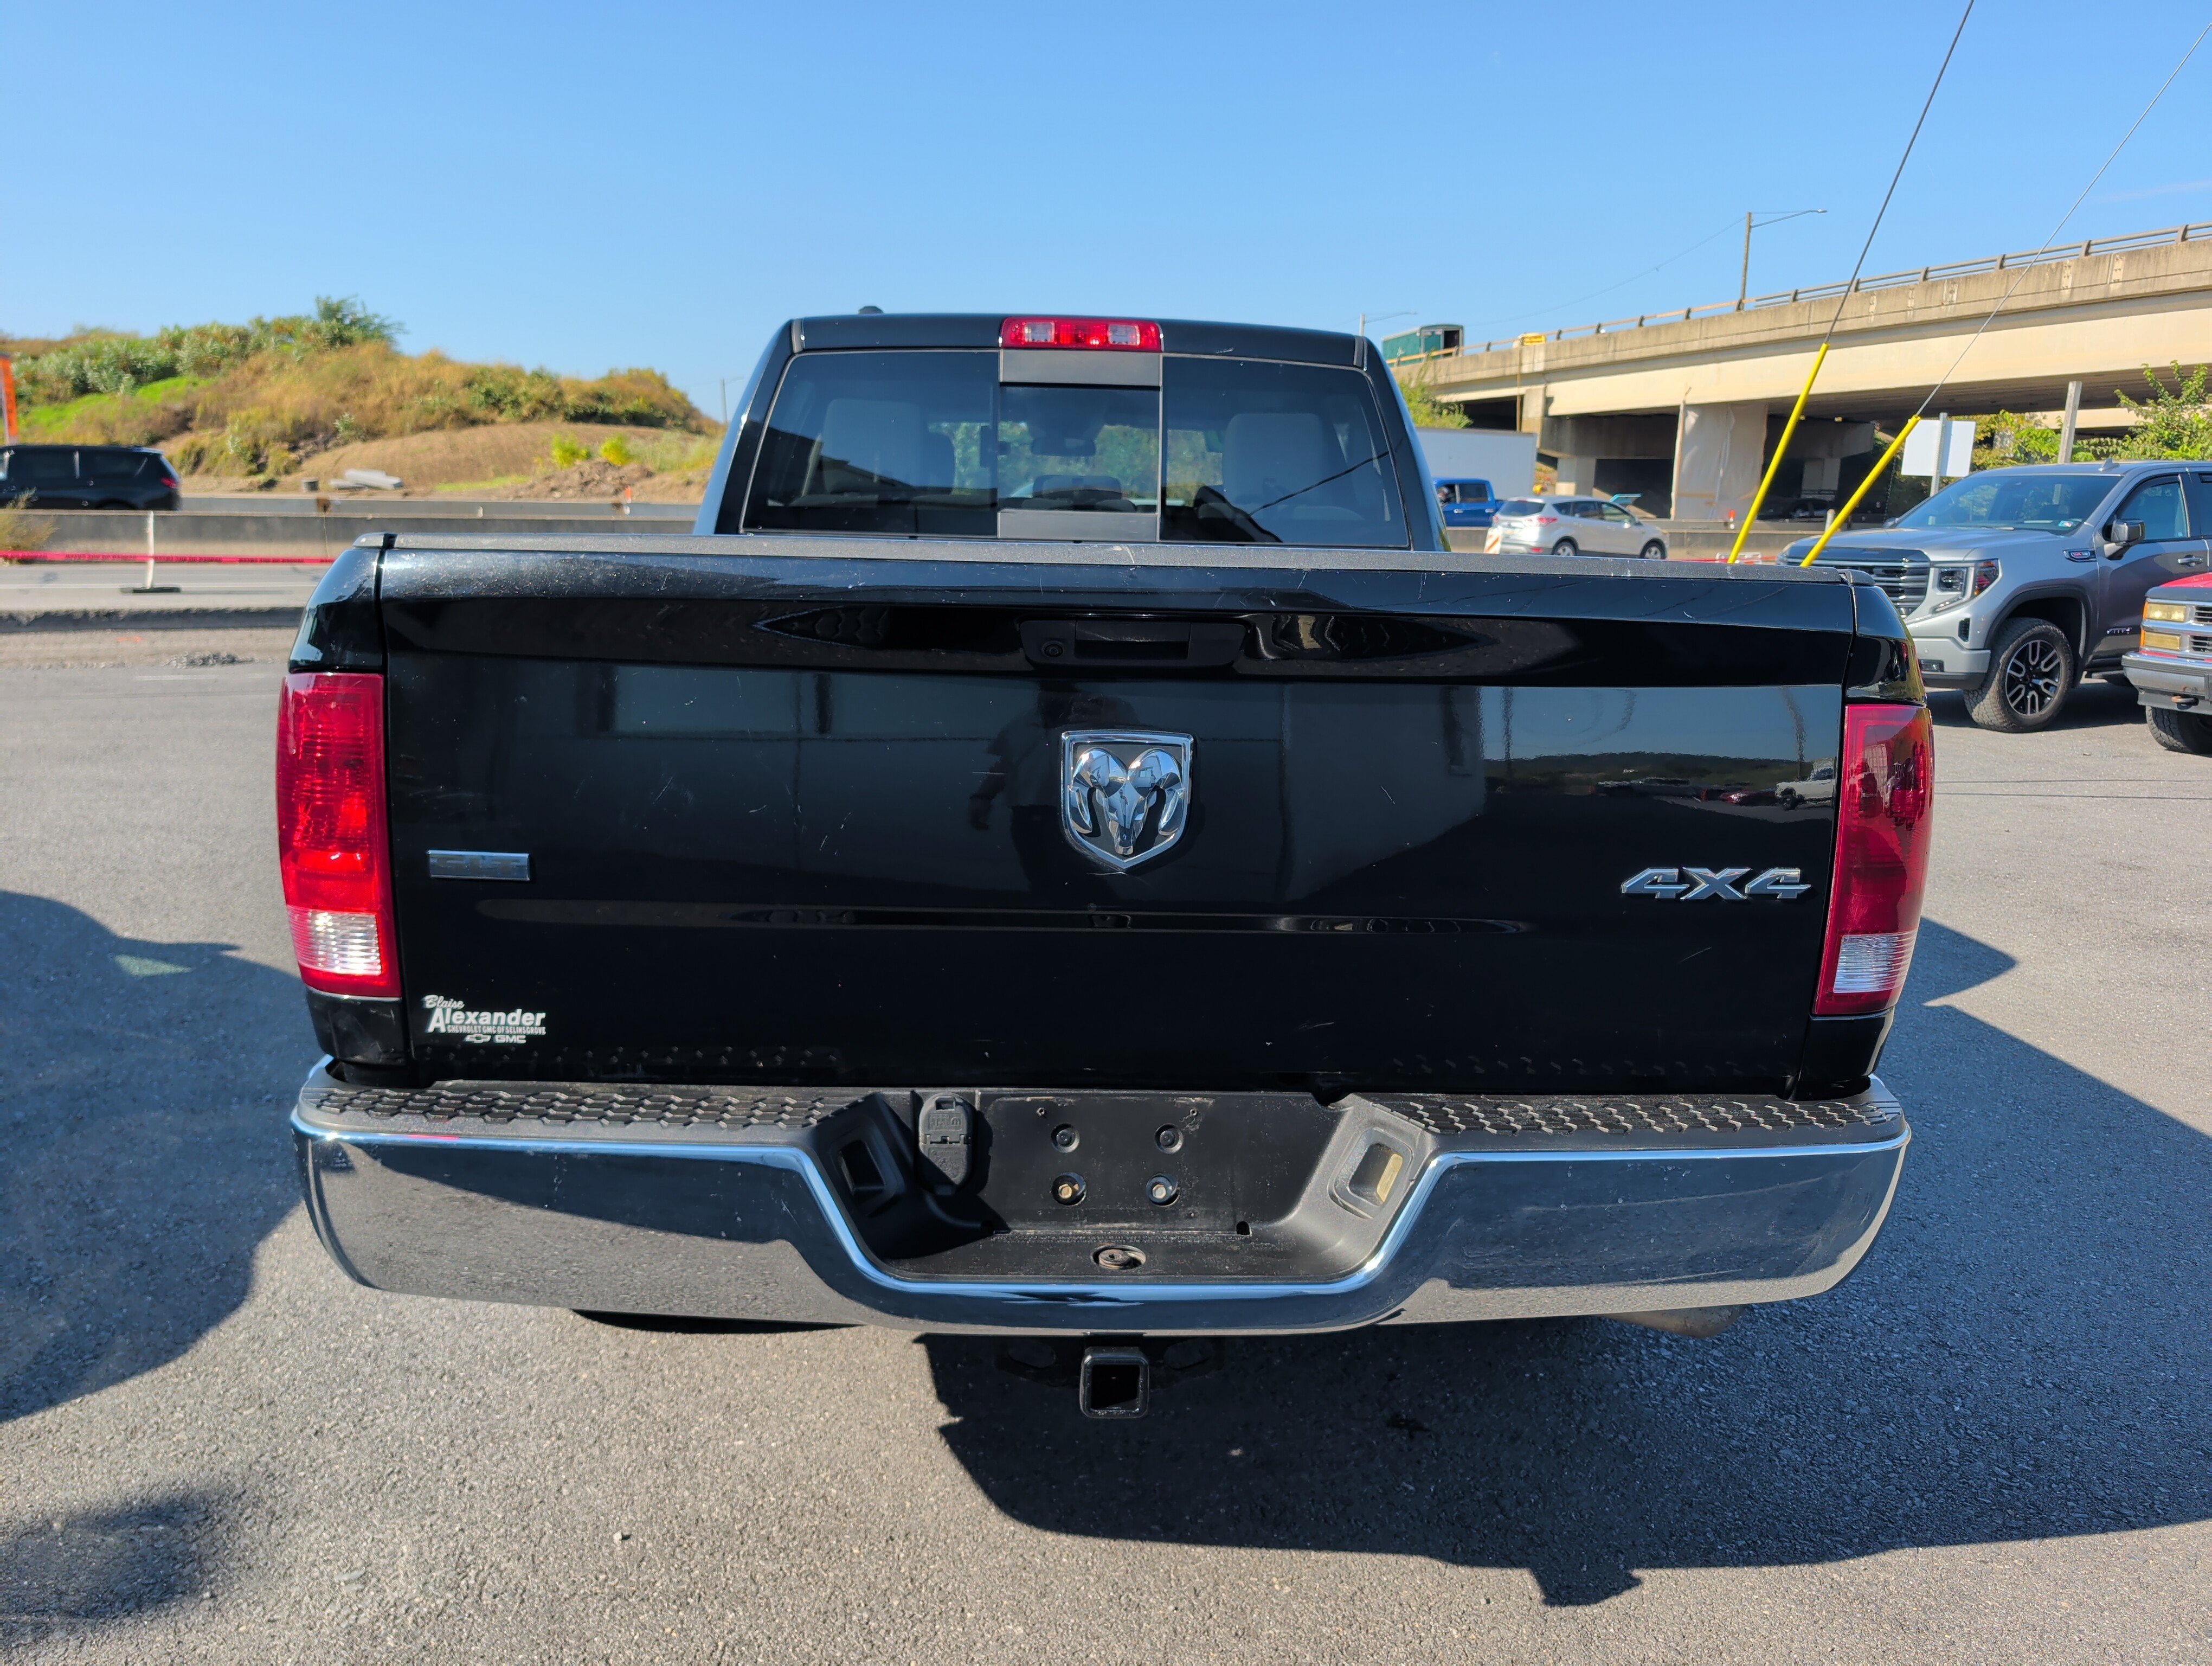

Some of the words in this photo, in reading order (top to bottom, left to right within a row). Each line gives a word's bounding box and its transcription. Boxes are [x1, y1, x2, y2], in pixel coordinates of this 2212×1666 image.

[1621, 867, 1811, 900] 4X4
[422, 995, 465, 1009] Blaise
[427, 1008, 546, 1033] Alexander
[447, 1025, 481, 1034] CHEVROLET
[482, 1026, 497, 1034] GMC
[497, 1026, 505, 1035] OF
[505, 1026, 546, 1035] SELINSGROVE
[494, 1035, 526, 1043] GMC
